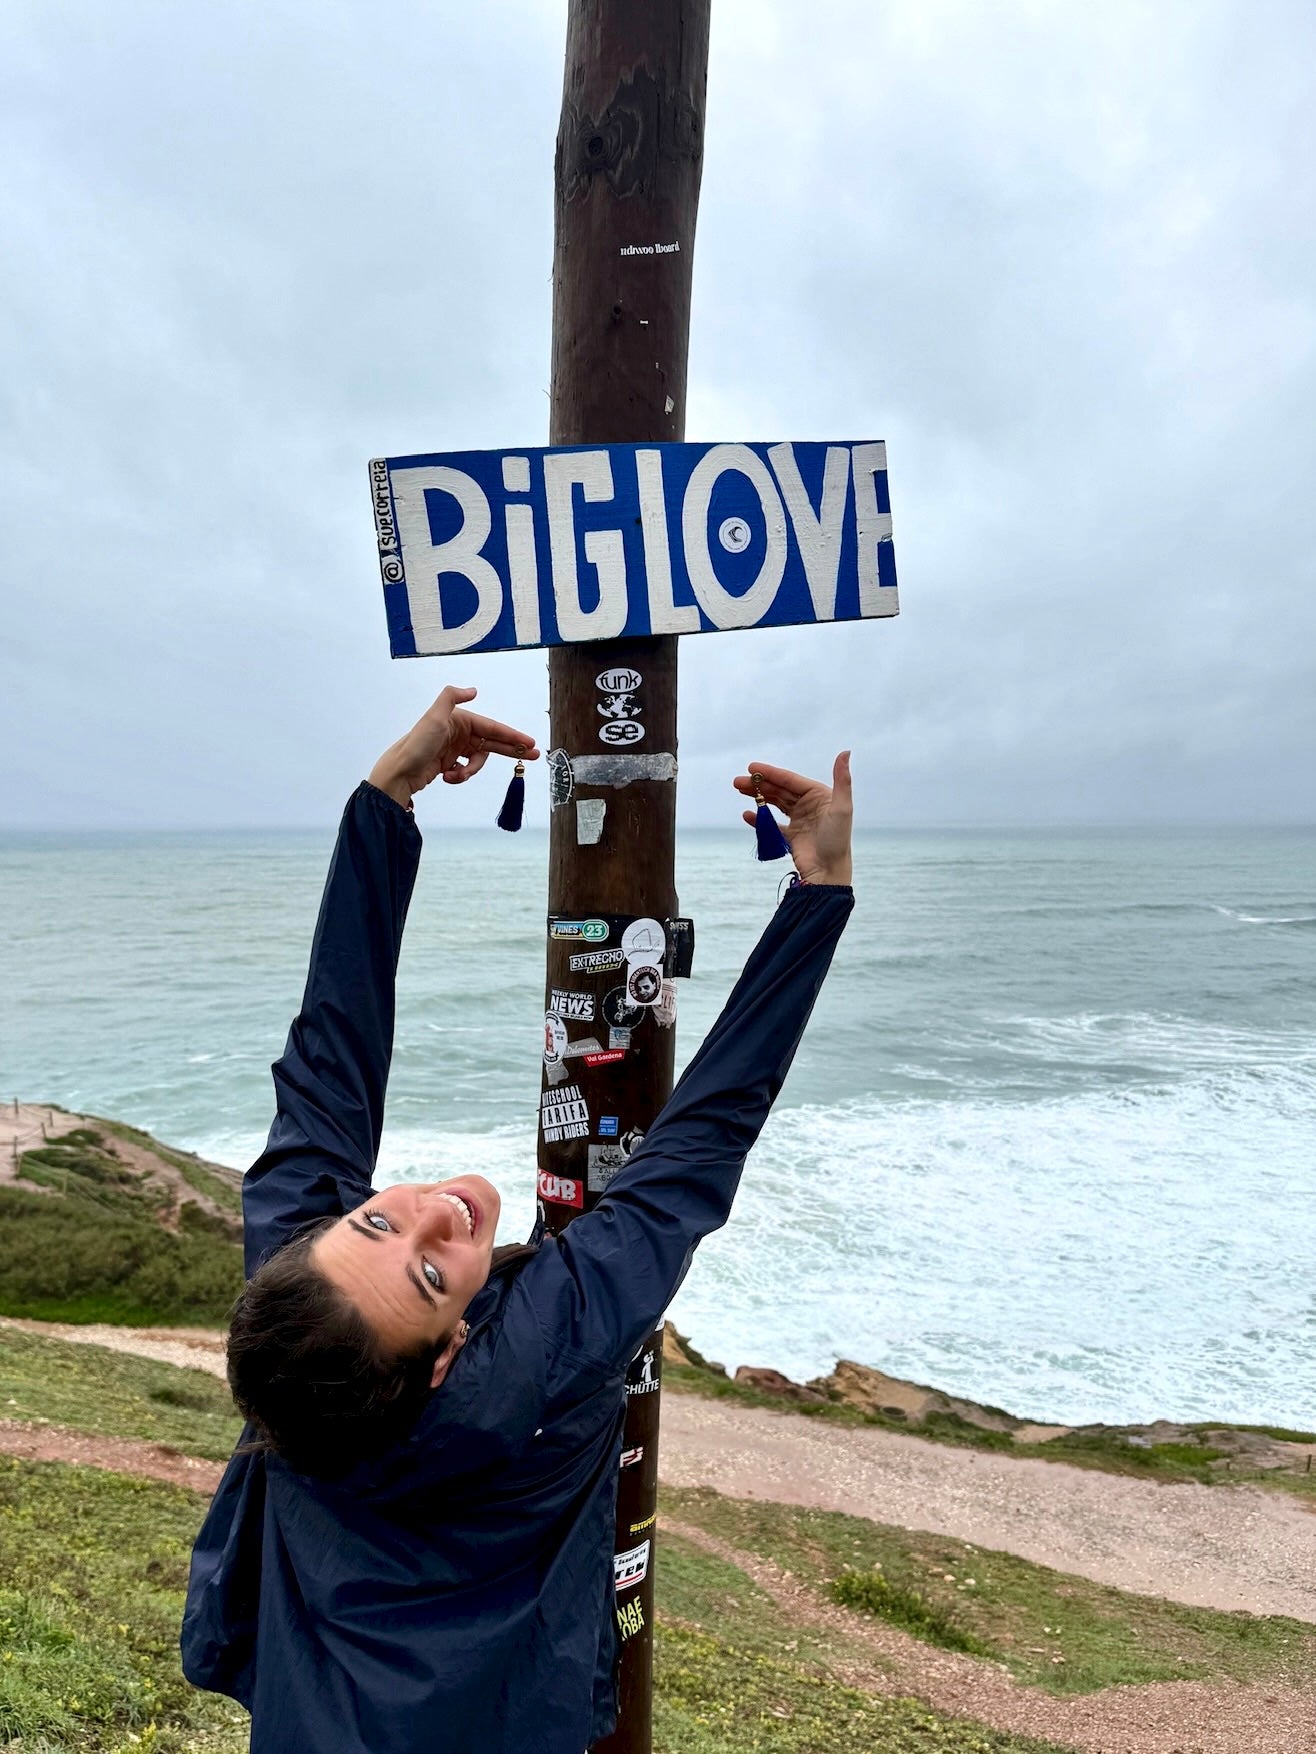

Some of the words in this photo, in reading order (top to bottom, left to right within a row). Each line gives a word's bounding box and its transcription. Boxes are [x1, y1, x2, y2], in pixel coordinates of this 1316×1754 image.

[635, 442, 900, 634] LOVE
[599, 670, 639, 690] funk
[586, 924, 604, 937] 23
[550, 994, 594, 1016] NEWS
[569, 992, 593, 1000] WORLD
[587, 1055, 597, 1063] Val
[598, 1052, 623, 1061] Gardena
[543, 1102, 586, 1126] TARIFA
[563, 1121, 590, 1140] RIDERS
[621, 1612, 645, 1641] OBA
